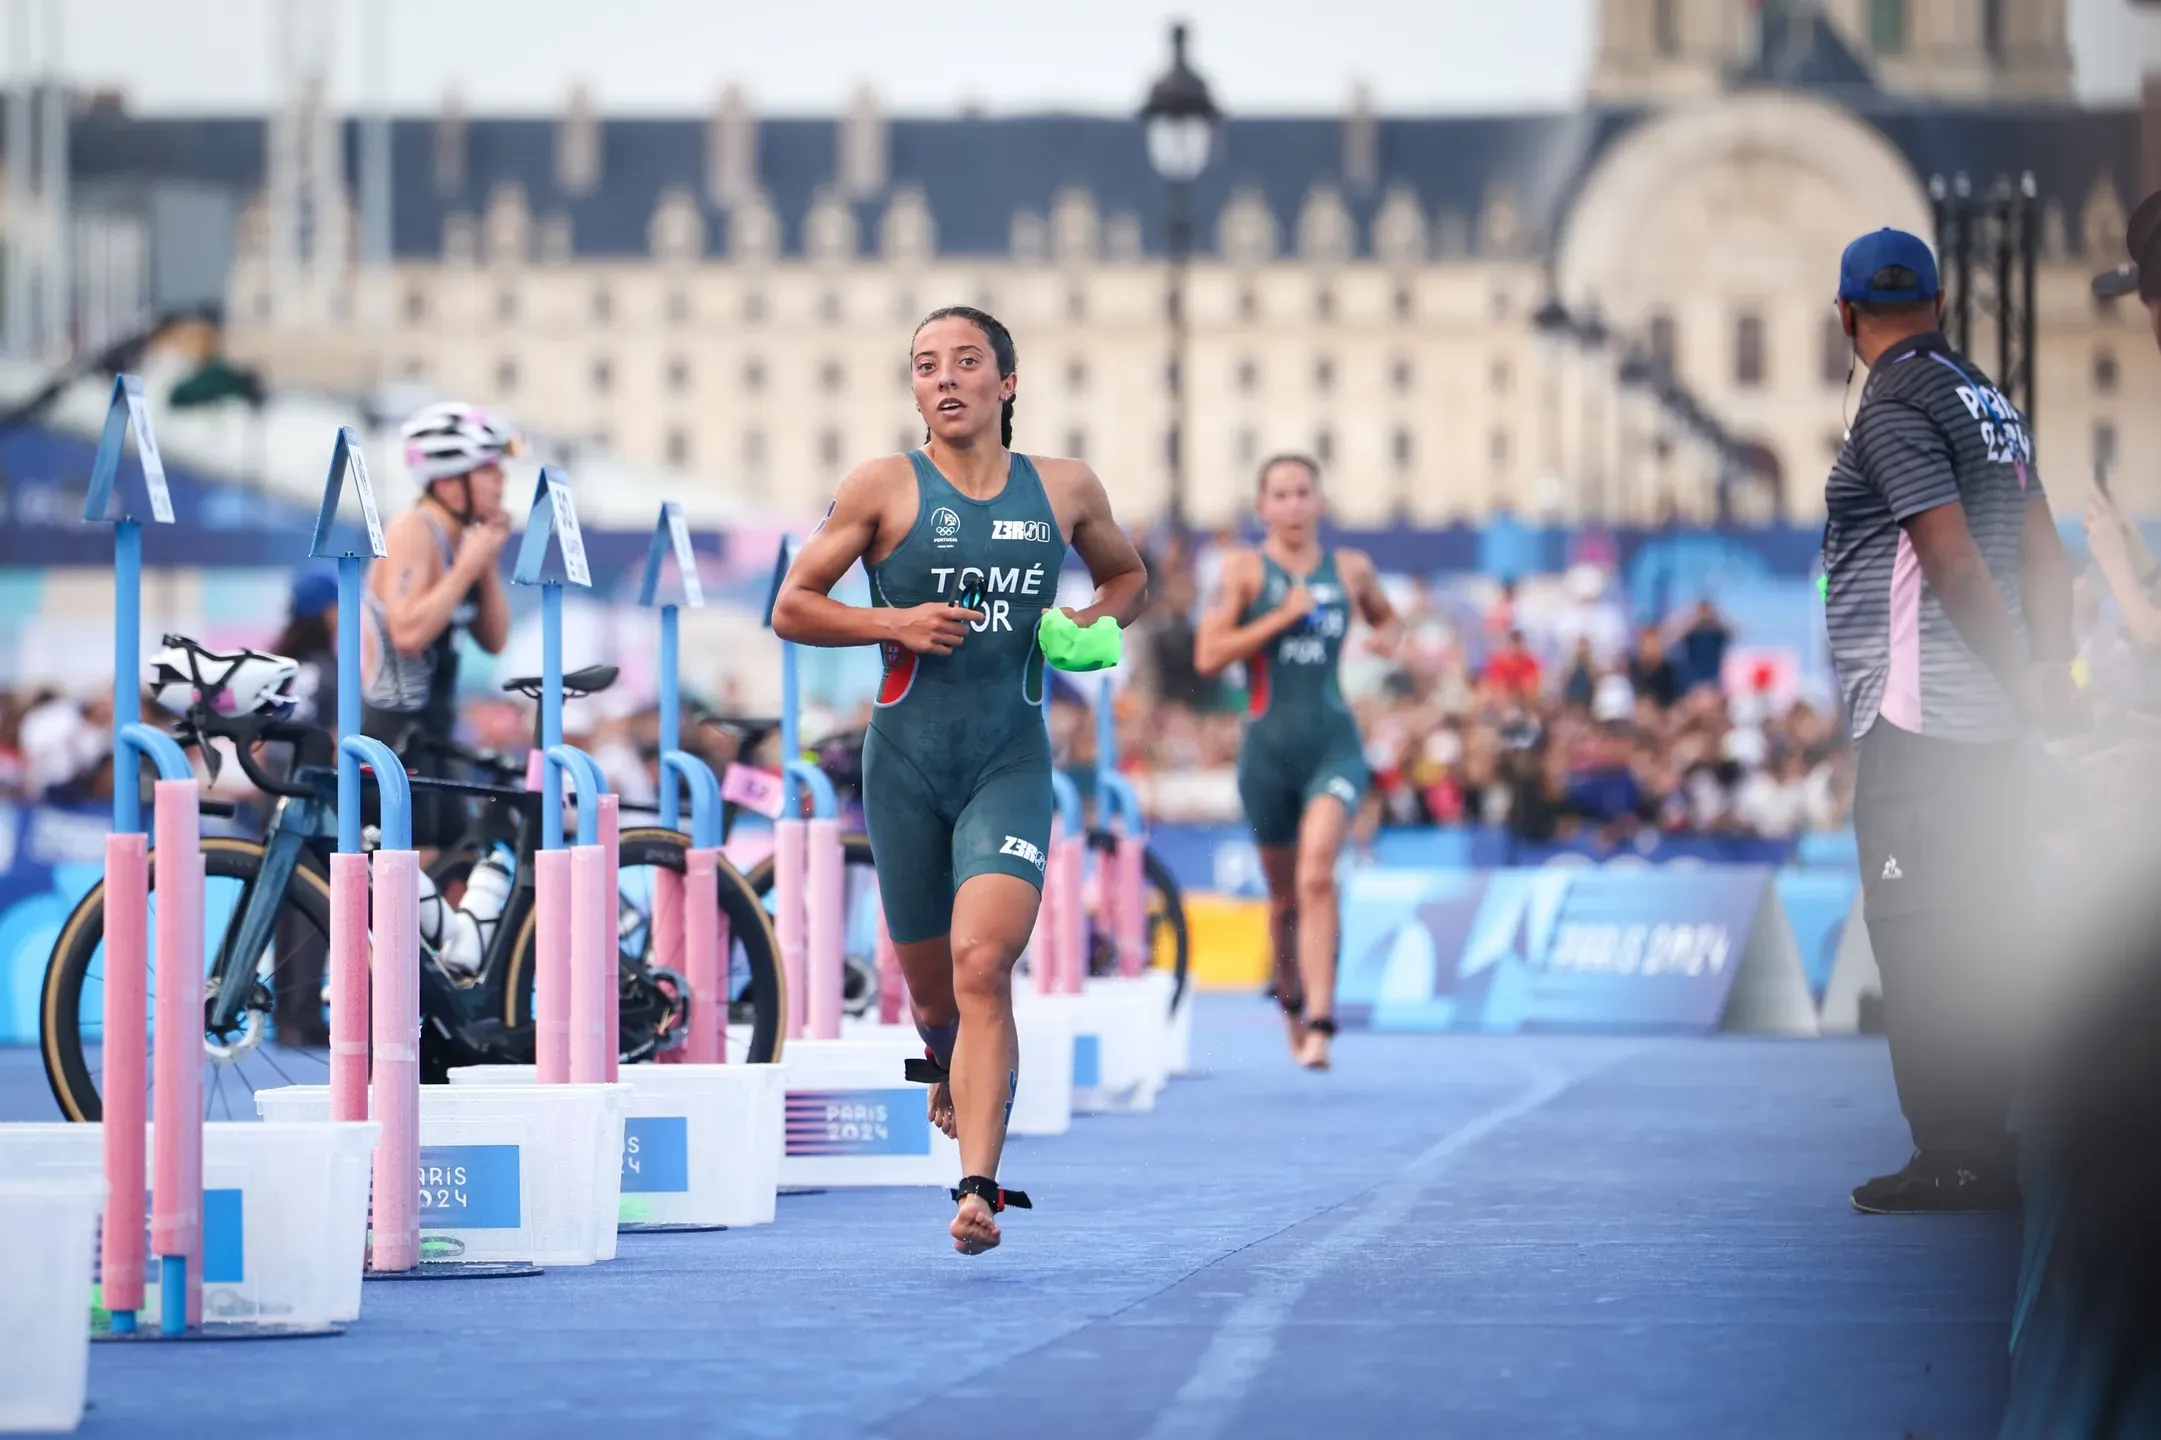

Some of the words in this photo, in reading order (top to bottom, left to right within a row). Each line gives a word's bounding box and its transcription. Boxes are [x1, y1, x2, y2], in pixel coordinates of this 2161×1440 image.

[931, 562, 1044, 595] TOMÉ
[953, 600, 1013, 633] OR
[826, 1122, 888, 1140] 2024
[418, 1189, 467, 1208] 024
